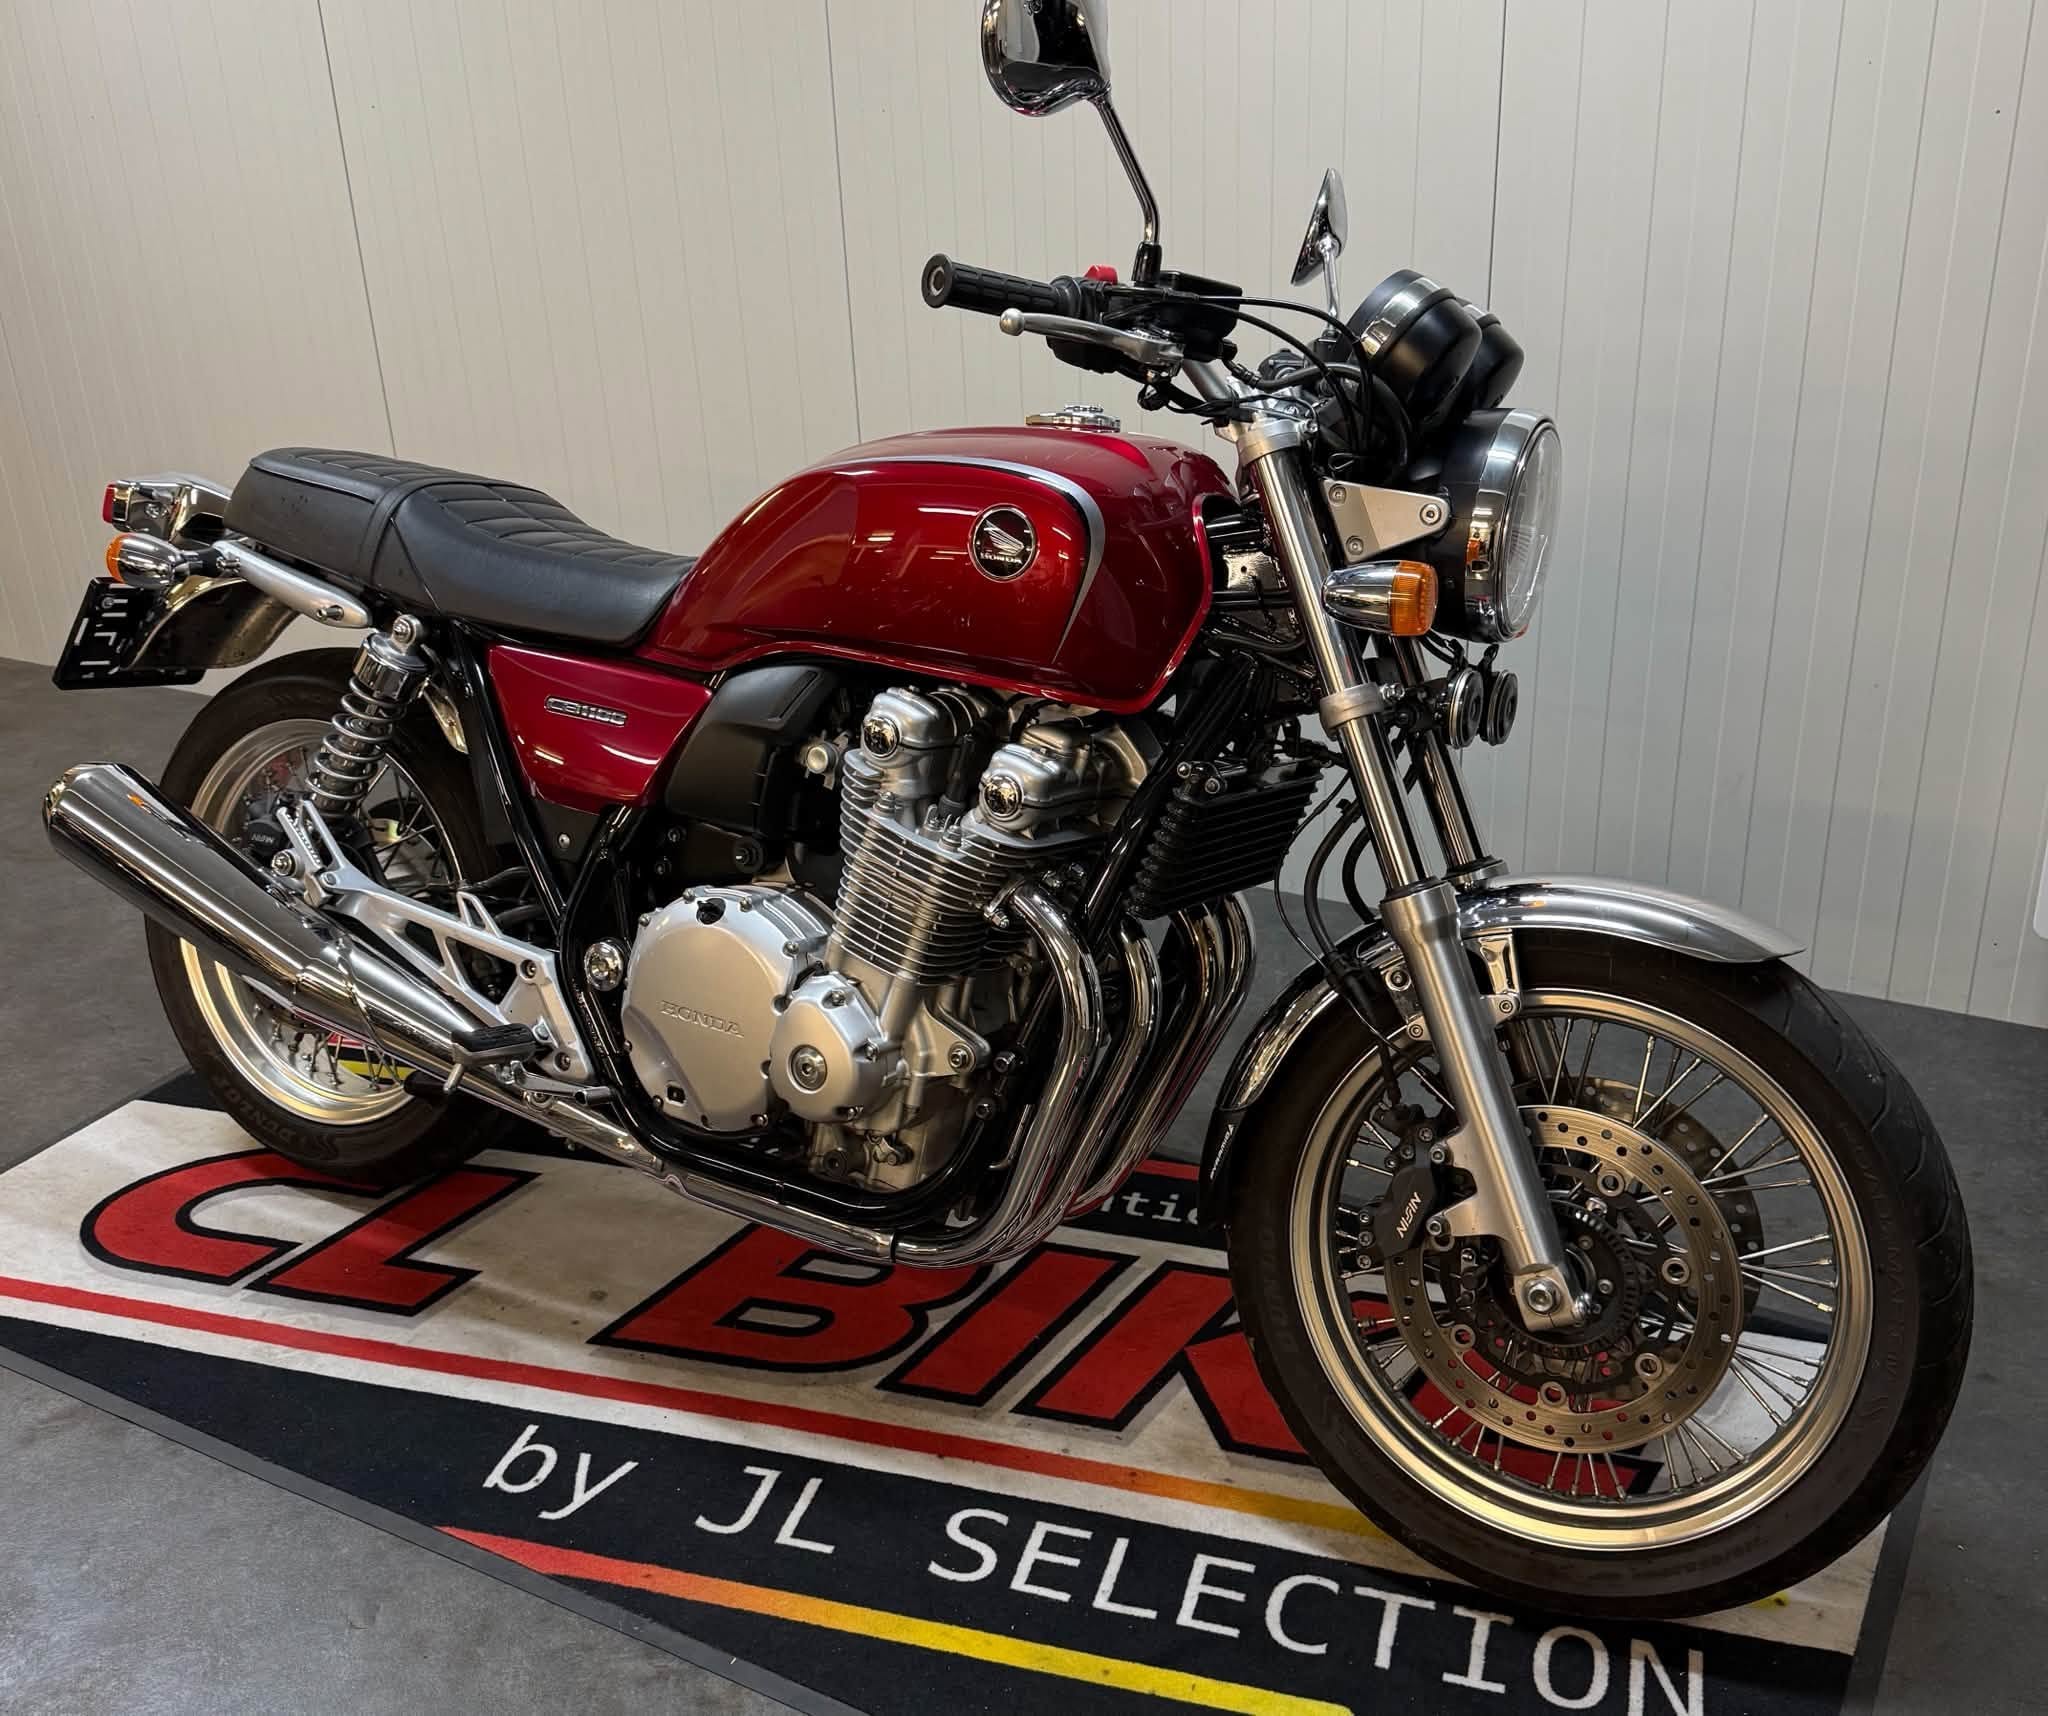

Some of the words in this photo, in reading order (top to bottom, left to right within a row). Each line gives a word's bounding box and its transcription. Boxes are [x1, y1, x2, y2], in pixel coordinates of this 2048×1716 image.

[979, 551, 1024, 565] HONDA
[545, 696, 628, 726] CB1100
[658, 999, 746, 1039] HONDA
[79, 1147, 542, 1317] CL
[1396, 1191, 1422, 1239] NISSIN
[482, 1424, 639, 1521] by
[695, 1465, 836, 1555] JL
[928, 1508, 1706, 1716] SELECTION
